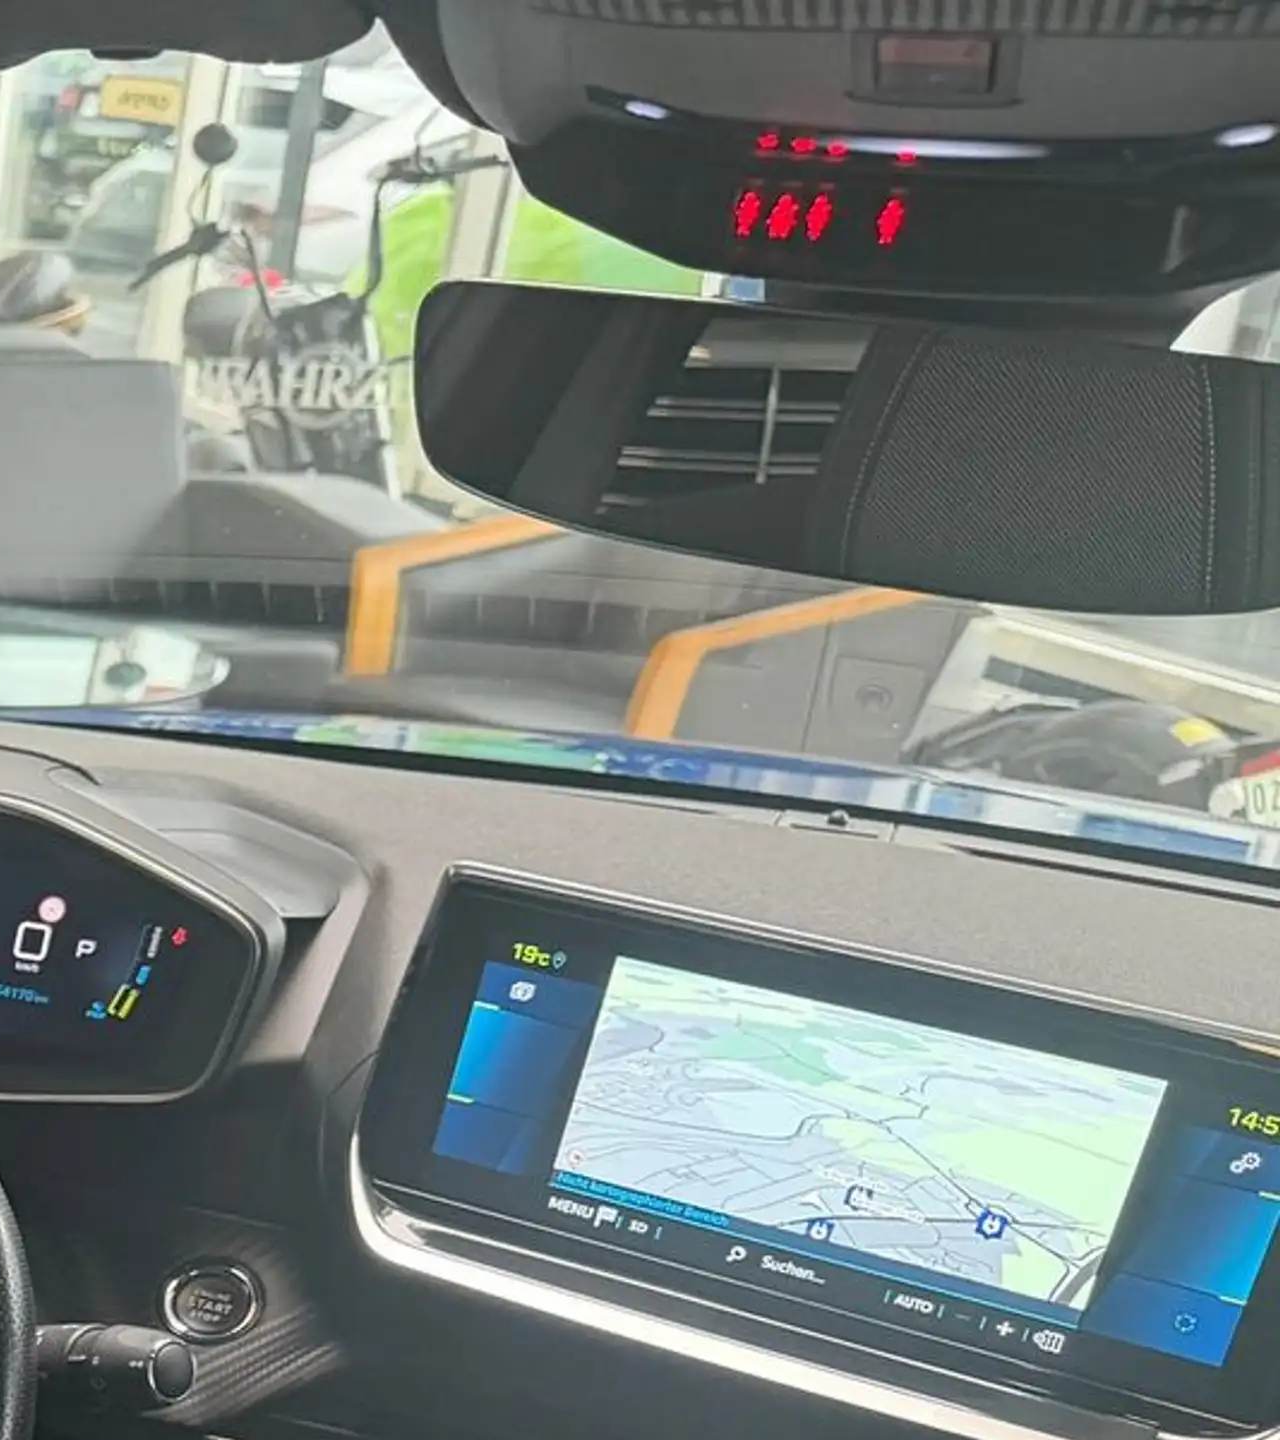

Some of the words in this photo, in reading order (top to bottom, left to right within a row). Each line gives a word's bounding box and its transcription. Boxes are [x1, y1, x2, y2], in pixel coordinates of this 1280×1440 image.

[74, 938, 98, 959] P
[547, 1195, 595, 1219] MENU
[893, 1293, 934, 1315] AUTO
